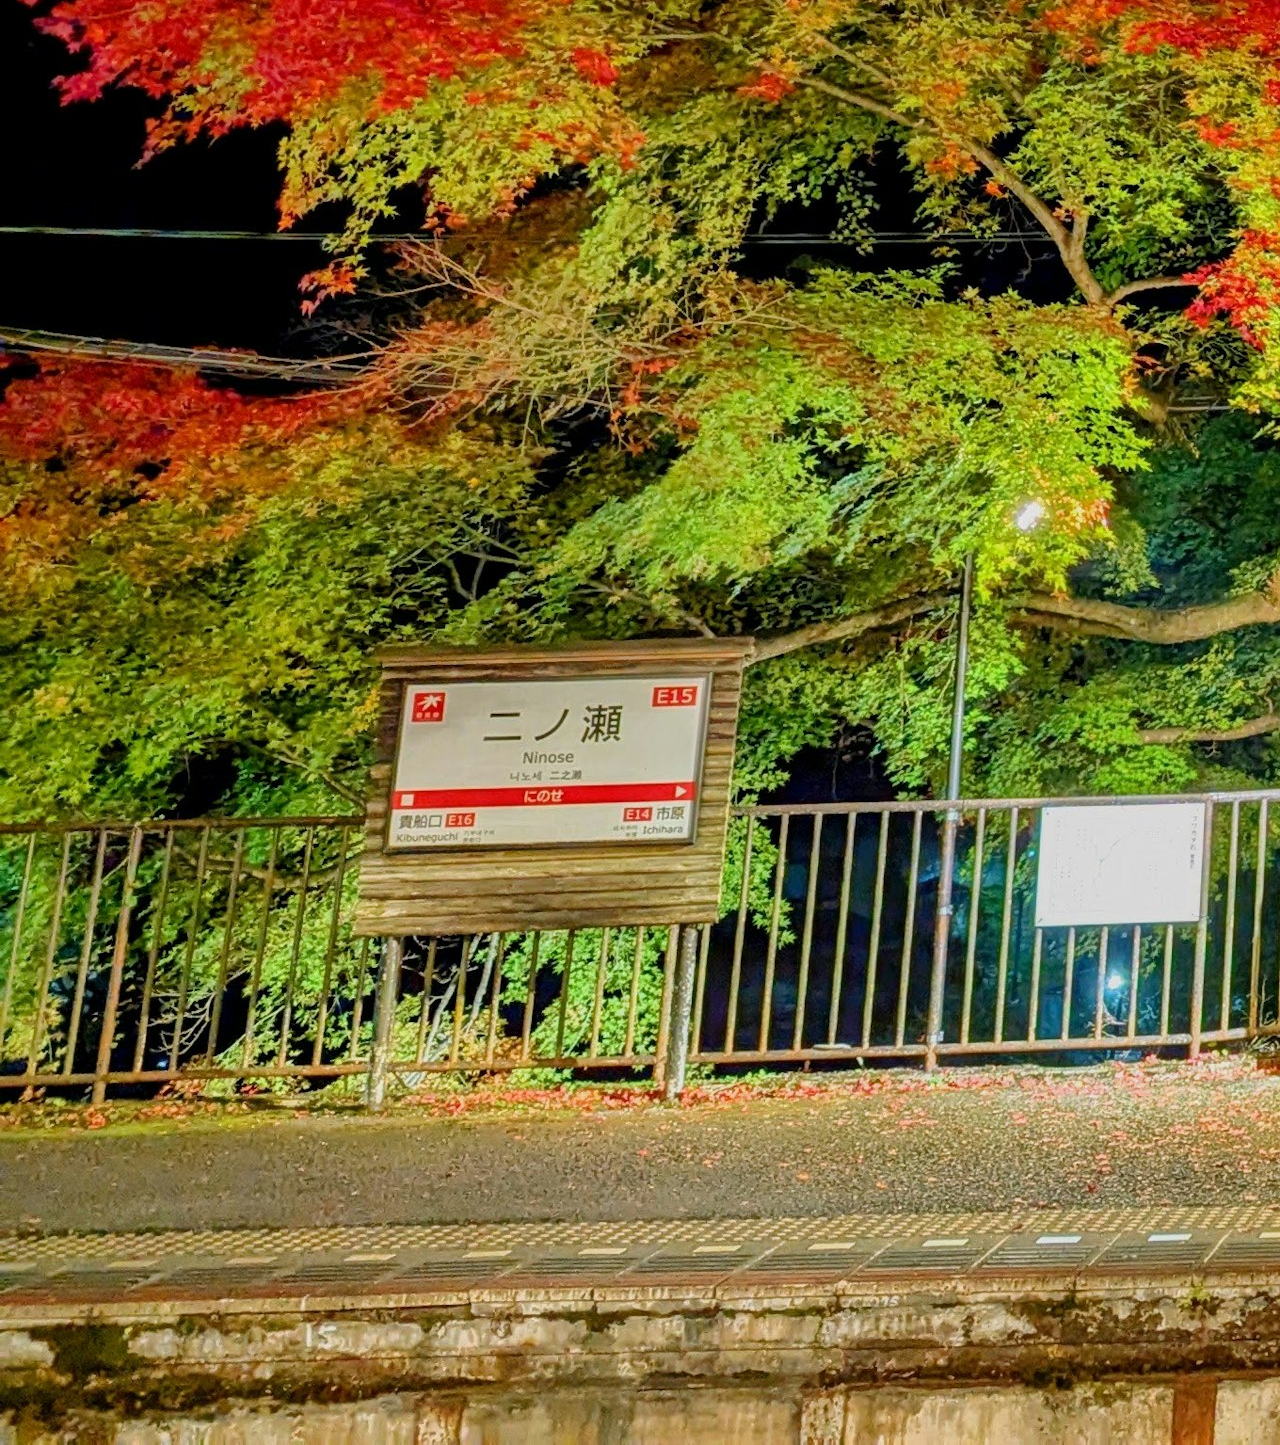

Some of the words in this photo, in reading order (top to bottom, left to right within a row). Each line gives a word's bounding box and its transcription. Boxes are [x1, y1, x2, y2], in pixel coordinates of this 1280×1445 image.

[656, 688, 693, 704] E15
[483, 705, 624, 743] 二ノ瀬
[522, 751, 575, 764] Ninose
[523, 790, 564, 803] にのせ
[625, 808, 650, 821] E14
[656, 806, 685, 821] 市原
[398, 814, 442, 829] 貴船口
[447, 814, 473, 826] E16
[642, 825, 683, 835] Ichihara
[396, 832, 459, 844] Kibuneguchi
